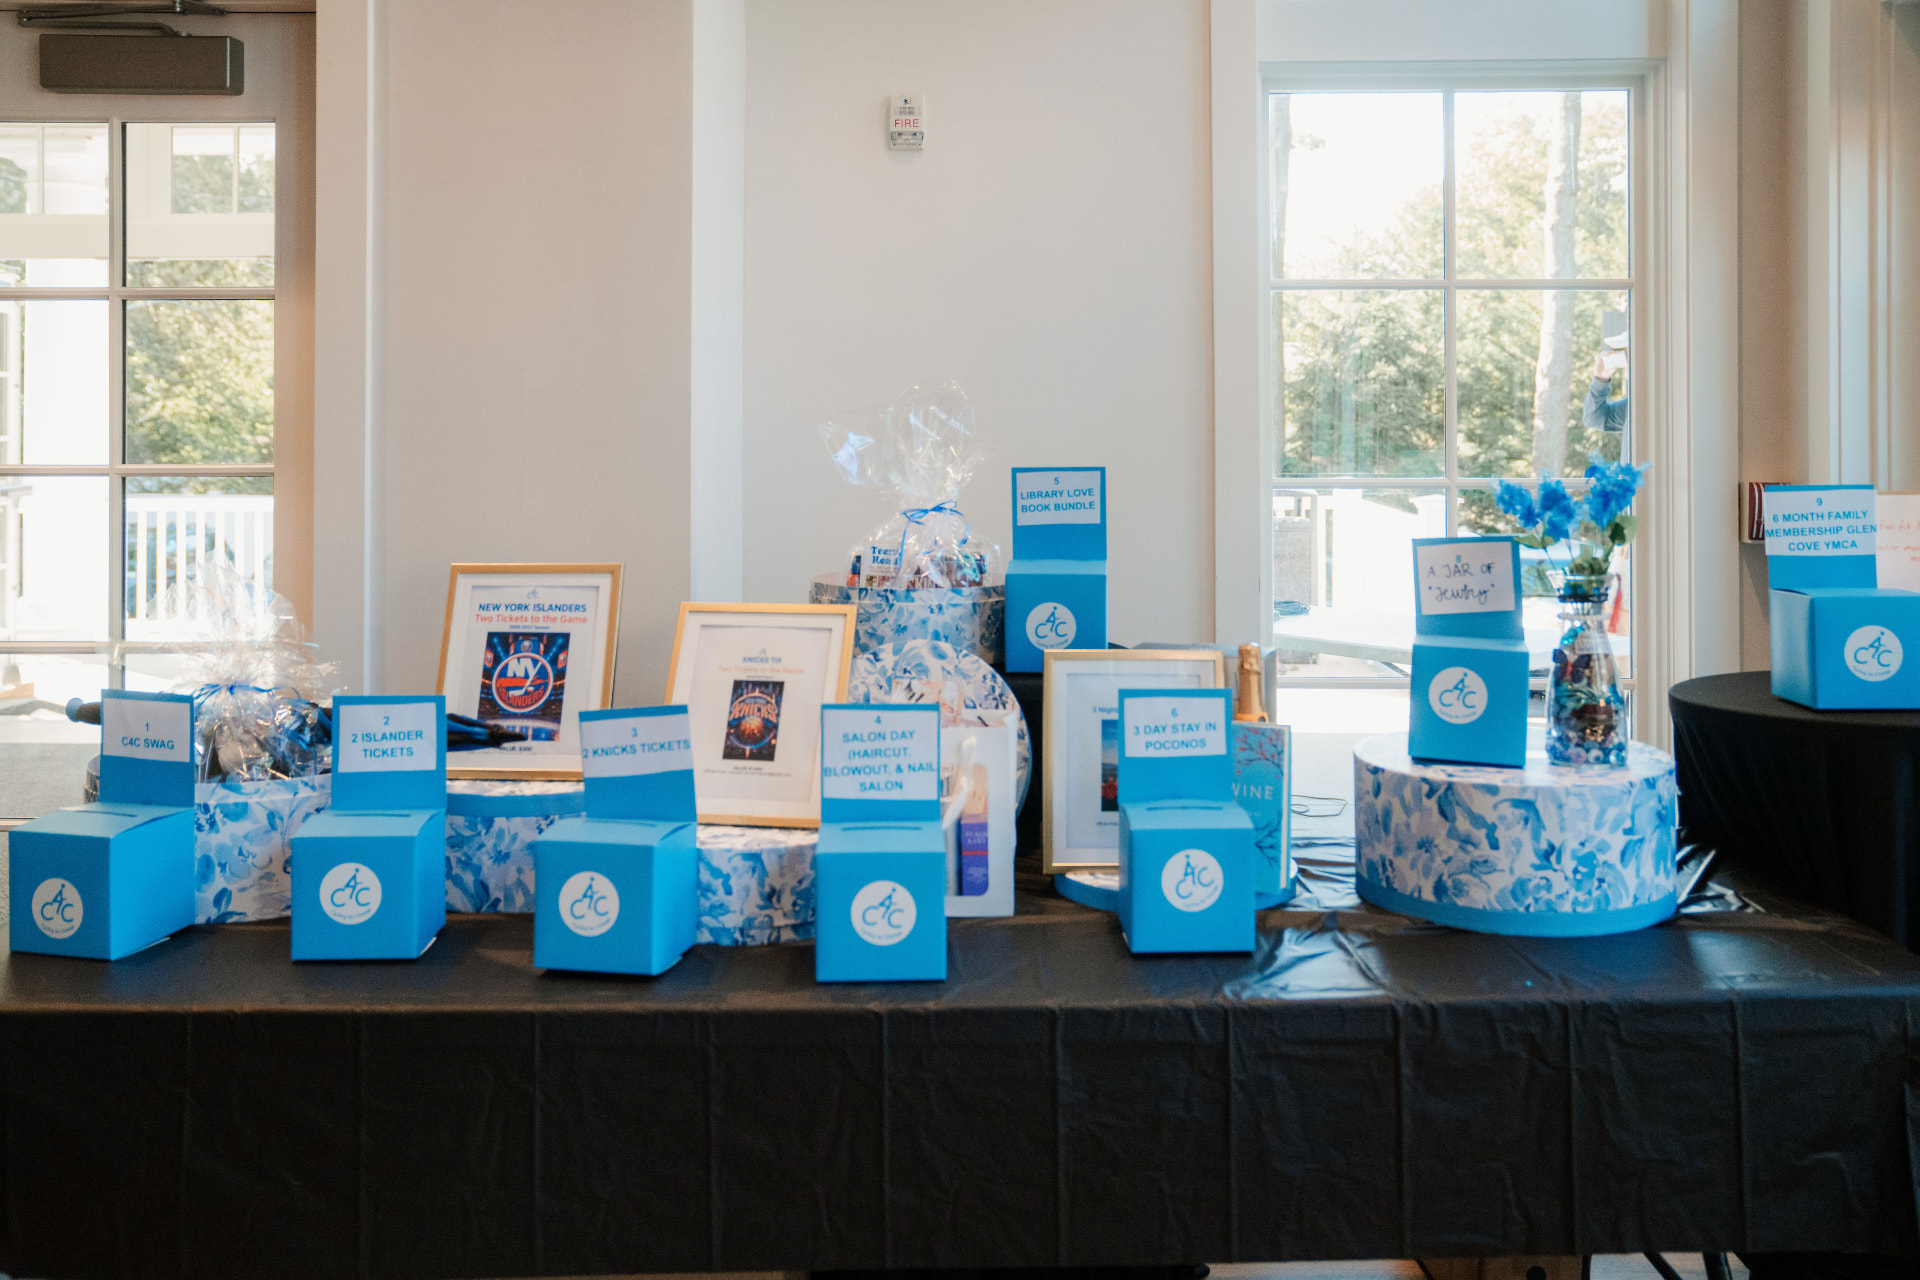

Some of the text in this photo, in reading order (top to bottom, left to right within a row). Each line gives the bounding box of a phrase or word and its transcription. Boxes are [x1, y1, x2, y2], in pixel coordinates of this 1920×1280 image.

[894, 119, 920, 128] FIRE
[1054, 477, 1060, 485] 5
[1020, 488, 1094, 500] LIBRARY LOVE
[1021, 501, 1095, 513] BOOK BUNDLE
[1816, 497, 1823, 506] 9
[1772, 510, 1868, 523] 6 MONTH FAMILY
[1766, 524, 1877, 538] MEMBERSHIP GLEN
[1788, 540, 1858, 552] COVE YMCA
[1427, 562, 1495, 578] A JAR OF
[478, 603, 587, 612] NEW YORK ISLANDERS
[474, 614, 588, 624] Two Tickets to the Game
[507, 657, 536, 678] NY
[729, 703, 777, 723] KNICKS
[1171, 708, 1178, 718] 6
[383, 716, 390, 725] 2
[875, 716, 882, 725] 4
[145, 722, 149, 732] 1
[631, 727, 638, 738] 3
[1133, 722, 1217, 736] 3 DAY STAY IN
[351, 730, 423, 743] 2 ISLANDER
[842, 730, 915, 743] SALON DAY
[121, 737, 175, 750] C4C SWAG
[582, 739, 691, 759] 2 KNICKS TICKETS
[1145, 738, 1206, 751] POCONOS
[362, 747, 414, 758] TICKETS
[895, 763, 903, 774] &
[908, 762, 937, 773] NAIL
[859, 780, 903, 792] SALON
